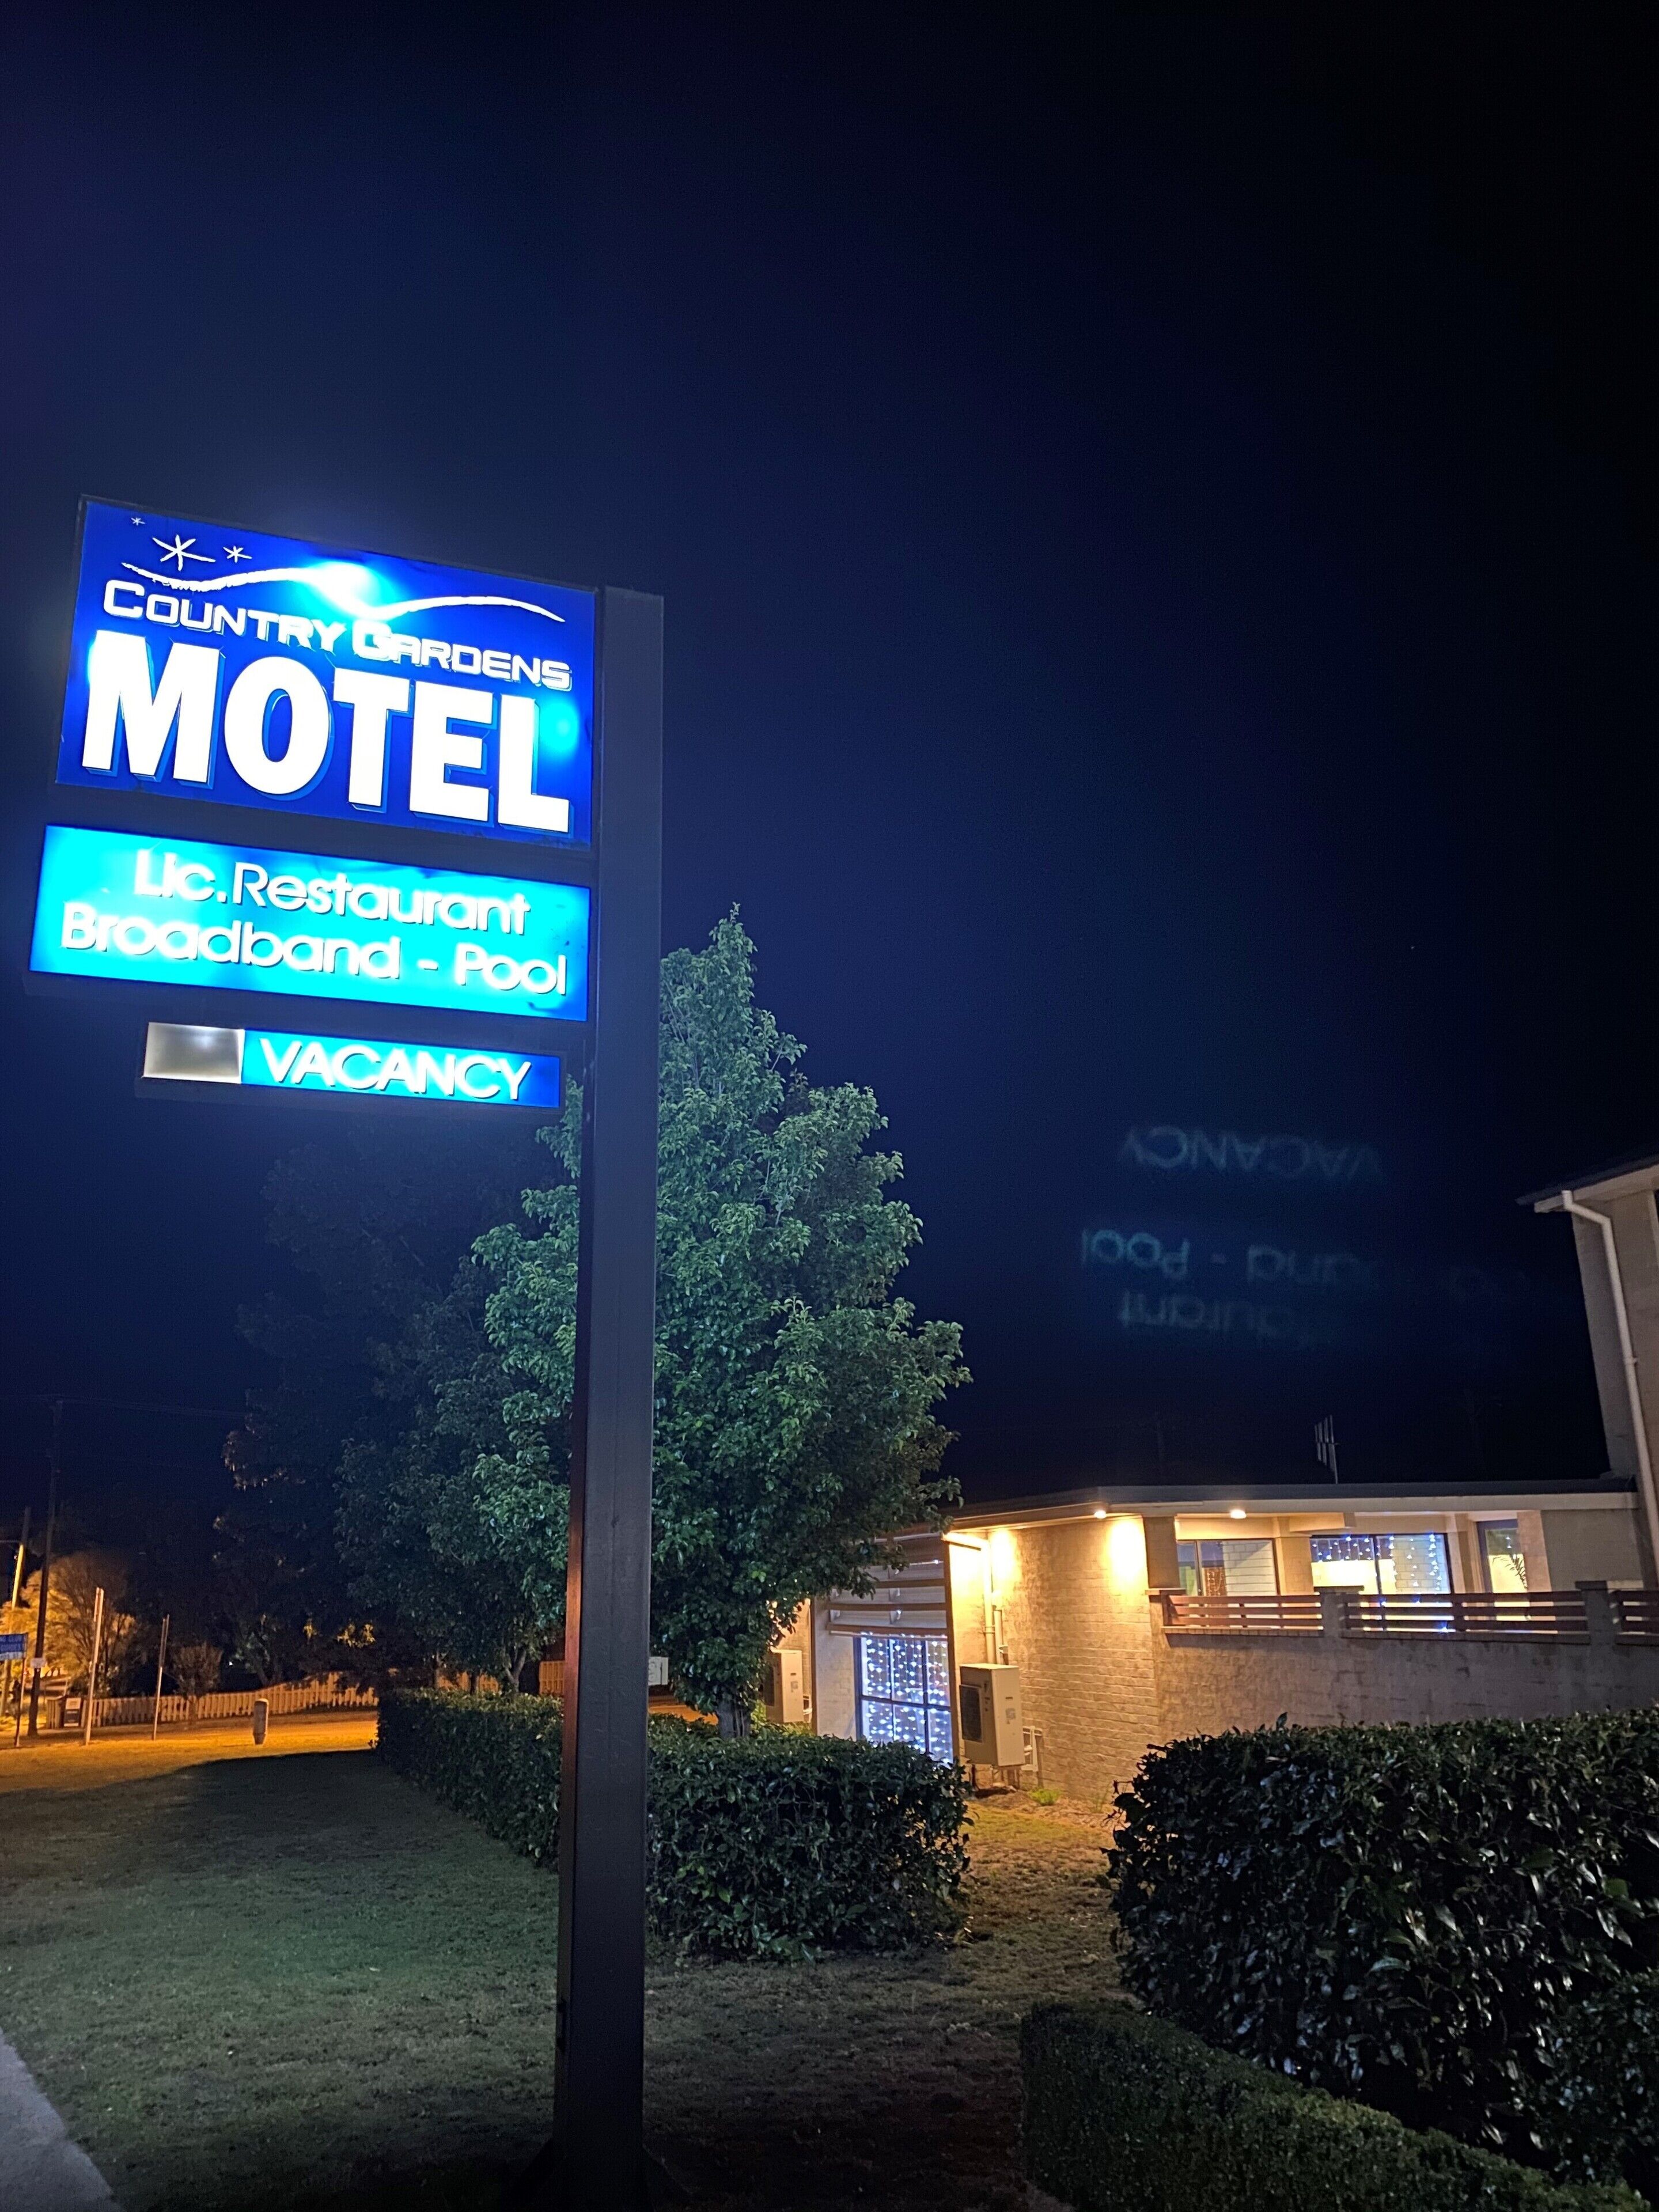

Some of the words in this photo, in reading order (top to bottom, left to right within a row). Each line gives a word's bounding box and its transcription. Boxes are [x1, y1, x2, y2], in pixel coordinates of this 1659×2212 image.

[104, 579, 346, 656] COUNTRY
[352, 619, 572, 691] GARDENS
[81, 629, 571, 834] MOTEL
[60, 902, 400, 979] Broadband
[454, 942, 566, 995] Pool
[260, 1037, 531, 1101] VACANCY
